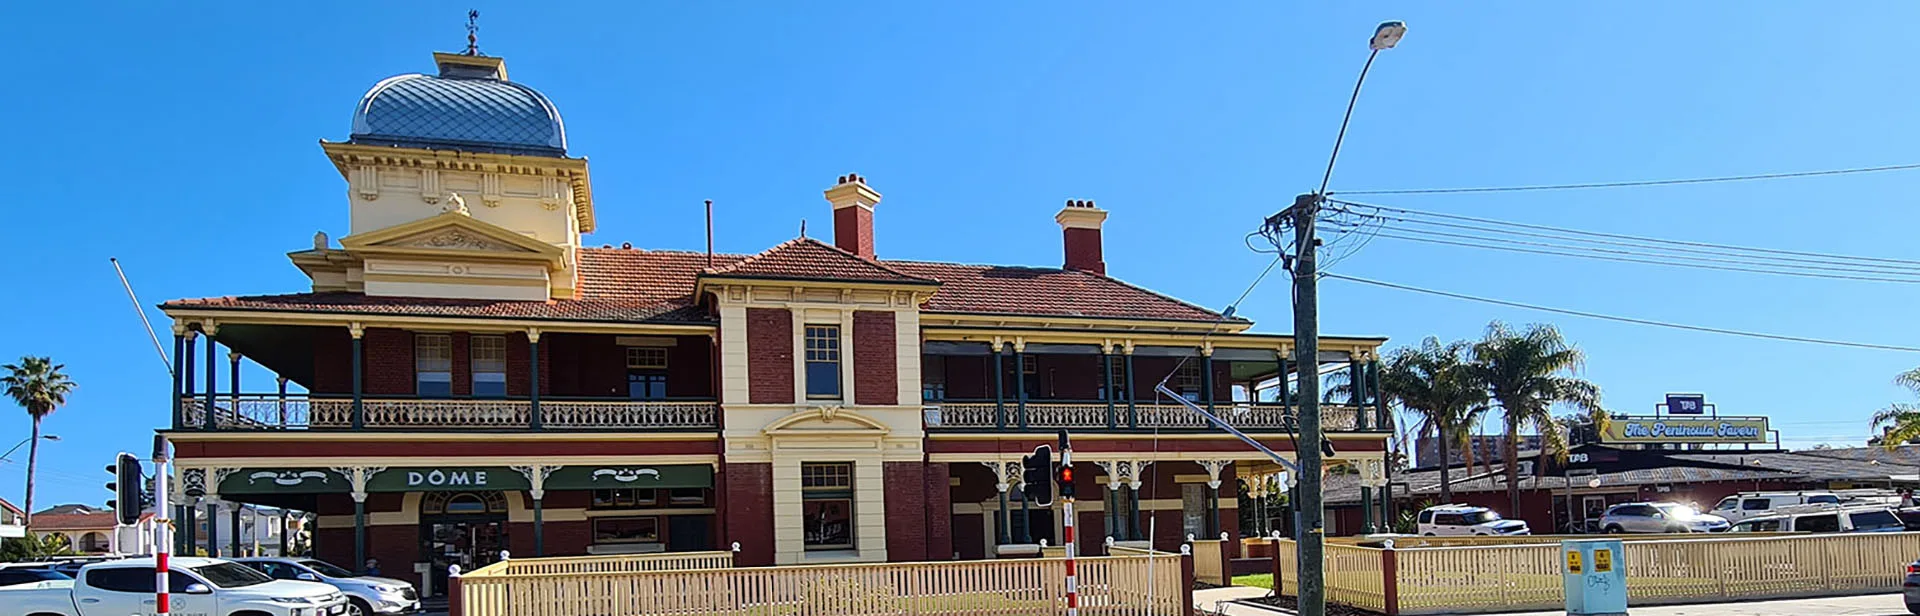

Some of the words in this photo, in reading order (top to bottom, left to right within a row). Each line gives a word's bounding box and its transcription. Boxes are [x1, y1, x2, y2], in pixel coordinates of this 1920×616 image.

[1624, 422, 1649, 437] The
[1717, 423, 1758, 437] Tavern
[407, 469, 487, 486] DÔME
